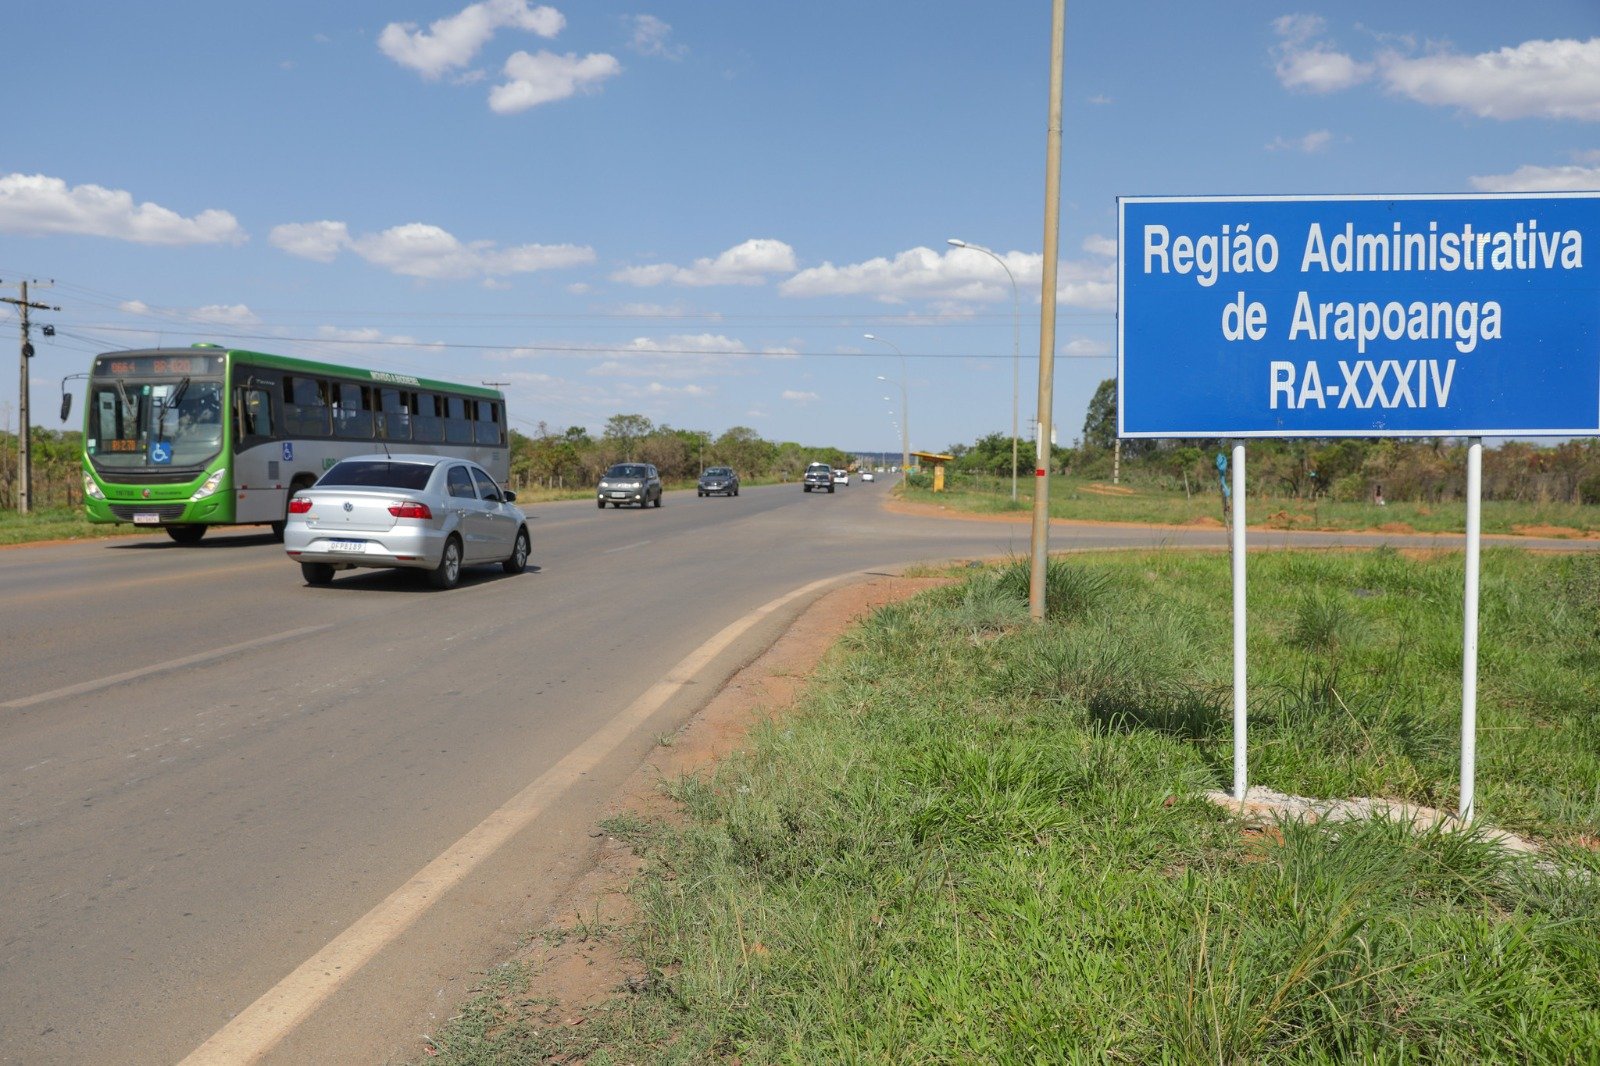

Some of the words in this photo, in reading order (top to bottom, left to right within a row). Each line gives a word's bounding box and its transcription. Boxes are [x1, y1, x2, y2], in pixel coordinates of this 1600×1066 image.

[1143, 222, 1279, 287] Região
[1300, 219, 1583, 273] Administrativa
[1221, 291, 1268, 341] de
[1288, 291, 1502, 353] Arapoanga
[1269, 358, 1457, 409] RA-XXXIV
